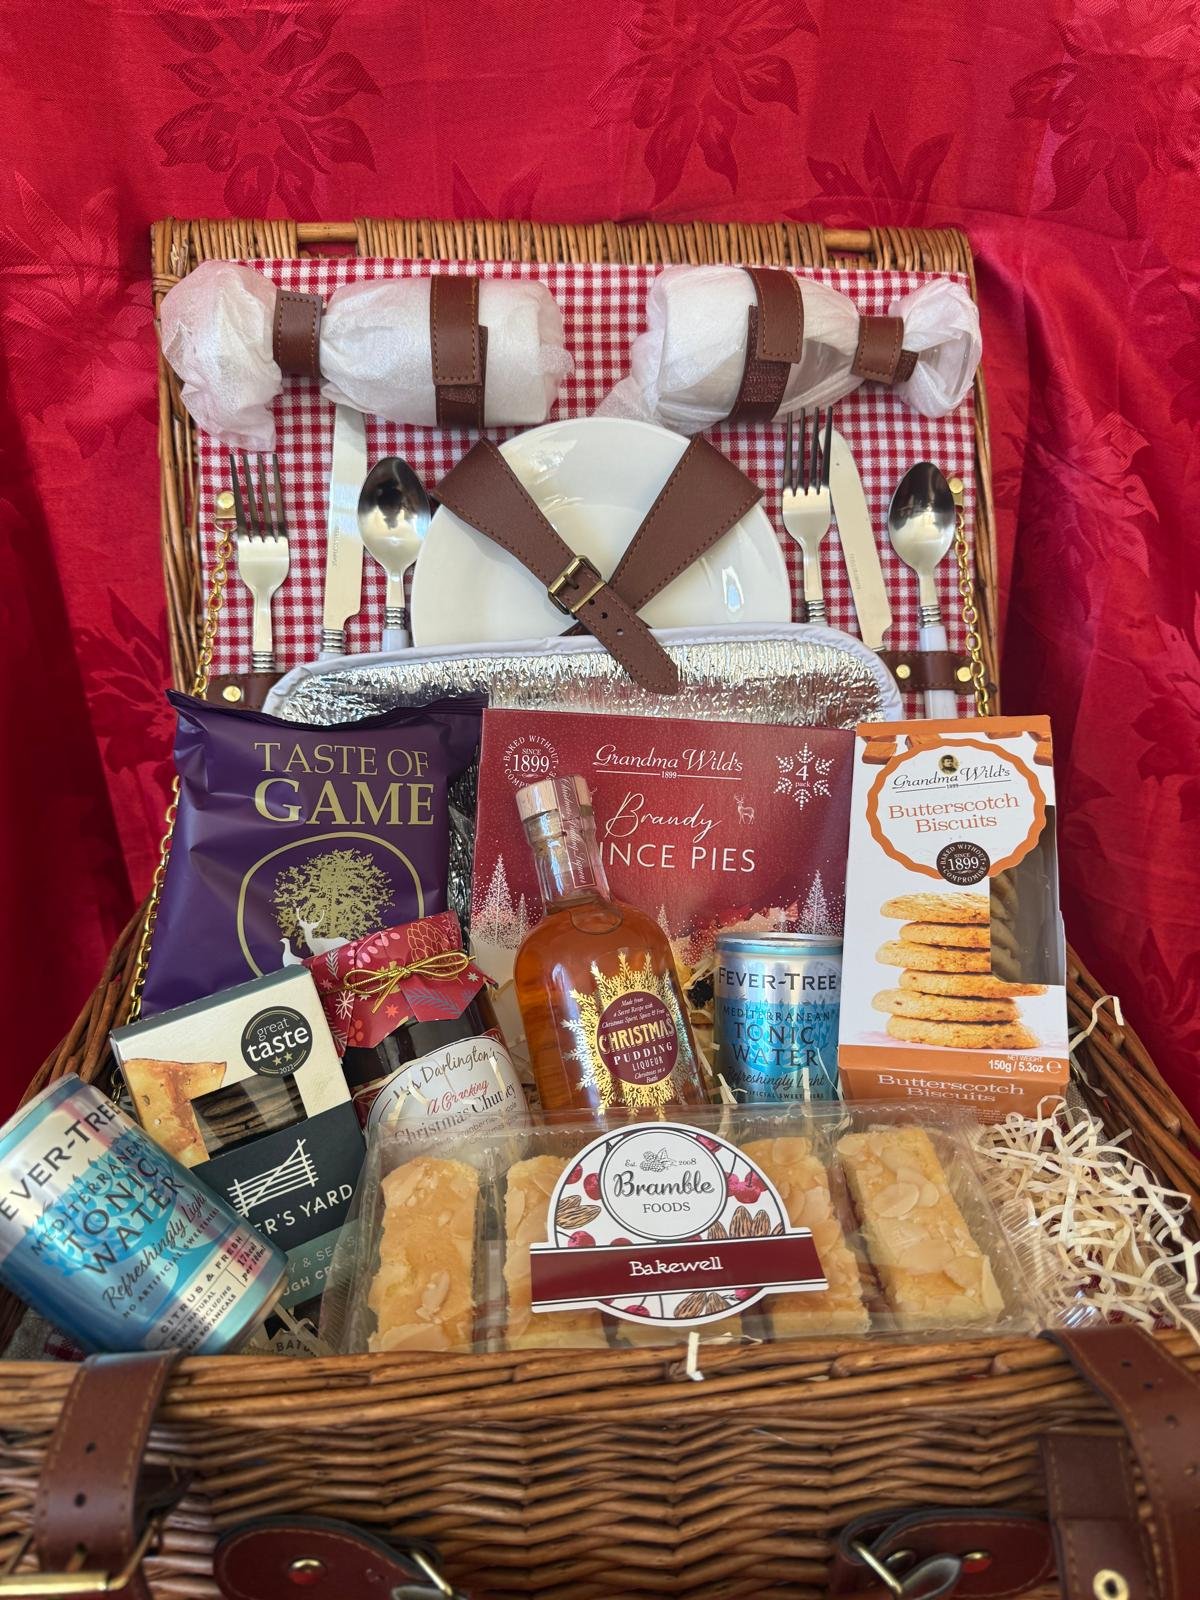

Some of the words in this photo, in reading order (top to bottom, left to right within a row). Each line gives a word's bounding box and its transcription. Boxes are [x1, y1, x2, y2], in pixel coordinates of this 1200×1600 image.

[254, 742, 378, 776] TASTE
[387, 748, 430, 777] OF
[503, 736, 525, 762] BAKED
[529, 735, 559, 764] WITHOUT
[522, 748, 542, 756] SINCE
[593, 744, 679, 768] Grandma
[682, 748, 744, 773] Wild's
[512, 754, 550, 772] 1899
[660, 770, 678, 780] 1899
[795, 765, 810, 781] 4
[794, 780, 812, 789] pack
[892, 771, 959, 790] Grandma
[960, 765, 1010, 780] Wild's
[254, 778, 435, 826] GAME
[888, 793, 1020, 820] Butterscotch
[604, 791, 723, 844] Brandy
[916, 814, 998, 834] Biscuits
[600, 841, 676, 869] INCE
[691, 846, 756, 873] PIES
[940, 846, 956, 865] BAKED
[958, 844, 986, 862] WITHOUT
[948, 856, 980, 871] 1899
[944, 866, 986, 883] COMPROMISE
[718, 966, 837, 990] FEVER-TREE
[723, 1006, 830, 1022] MEDITERRANEAN
[256, 1016, 290, 1042] great
[598, 1018, 675, 1054] CHRISTMAS
[734, 1022, 814, 1045] TONIC
[246, 1026, 310, 1062] taste
[613, 1041, 673, 1066] PUDDING
[732, 1043, 818, 1066] WATER
[632, 1056, 664, 1072] LIQUEUR
[988, 1058, 1012, 1074] 150g
[1018, 1062, 1044, 1074] 5.3oz
[1007, 1054, 1019, 1062] NET
[1020, 1055, 1043, 1063] WEIGHT
[440, 1078, 490, 1110] Cracking
[878, 1074, 1025, 1096] Butterscotch
[906, 1086, 996, 1102] Biscuits
[394, 1107, 470, 1145] Christmas
[0, 1099, 122, 1222] EVER-TREE
[624, 1159, 638, 1168] Est.
[678, 1158, 697, 1166] 2008
[30, 1133, 150, 1257] MEDITERRANEAN
[613, 1170, 716, 1198] Bramble
[64, 1157, 160, 1252] TONIC
[300, 1184, 353, 1218] YARD
[643, 1201, 691, 1214] FOODS
[83, 1175, 186, 1277] WATER
[102, 1216, 188, 1310] Refreshingly
[181, 1190, 208, 1226] Light
[304, 1257, 312, 1268] &
[242, 1264, 254, 1282] per
[629, 1256, 724, 1277] Bakewell
[123, 1303, 138, 1320] NO
[138, 1251, 184, 1302] ARTIFICIAL
[160, 1286, 204, 1334] CITRUS
[206, 1273, 214, 1282] &
[215, 1236, 244, 1269] FRESH
[187, 1290, 216, 1322] NATURAL
[198, 1286, 232, 1326] INCLUDING
[200, 1294, 236, 1336] BOTANICALS
